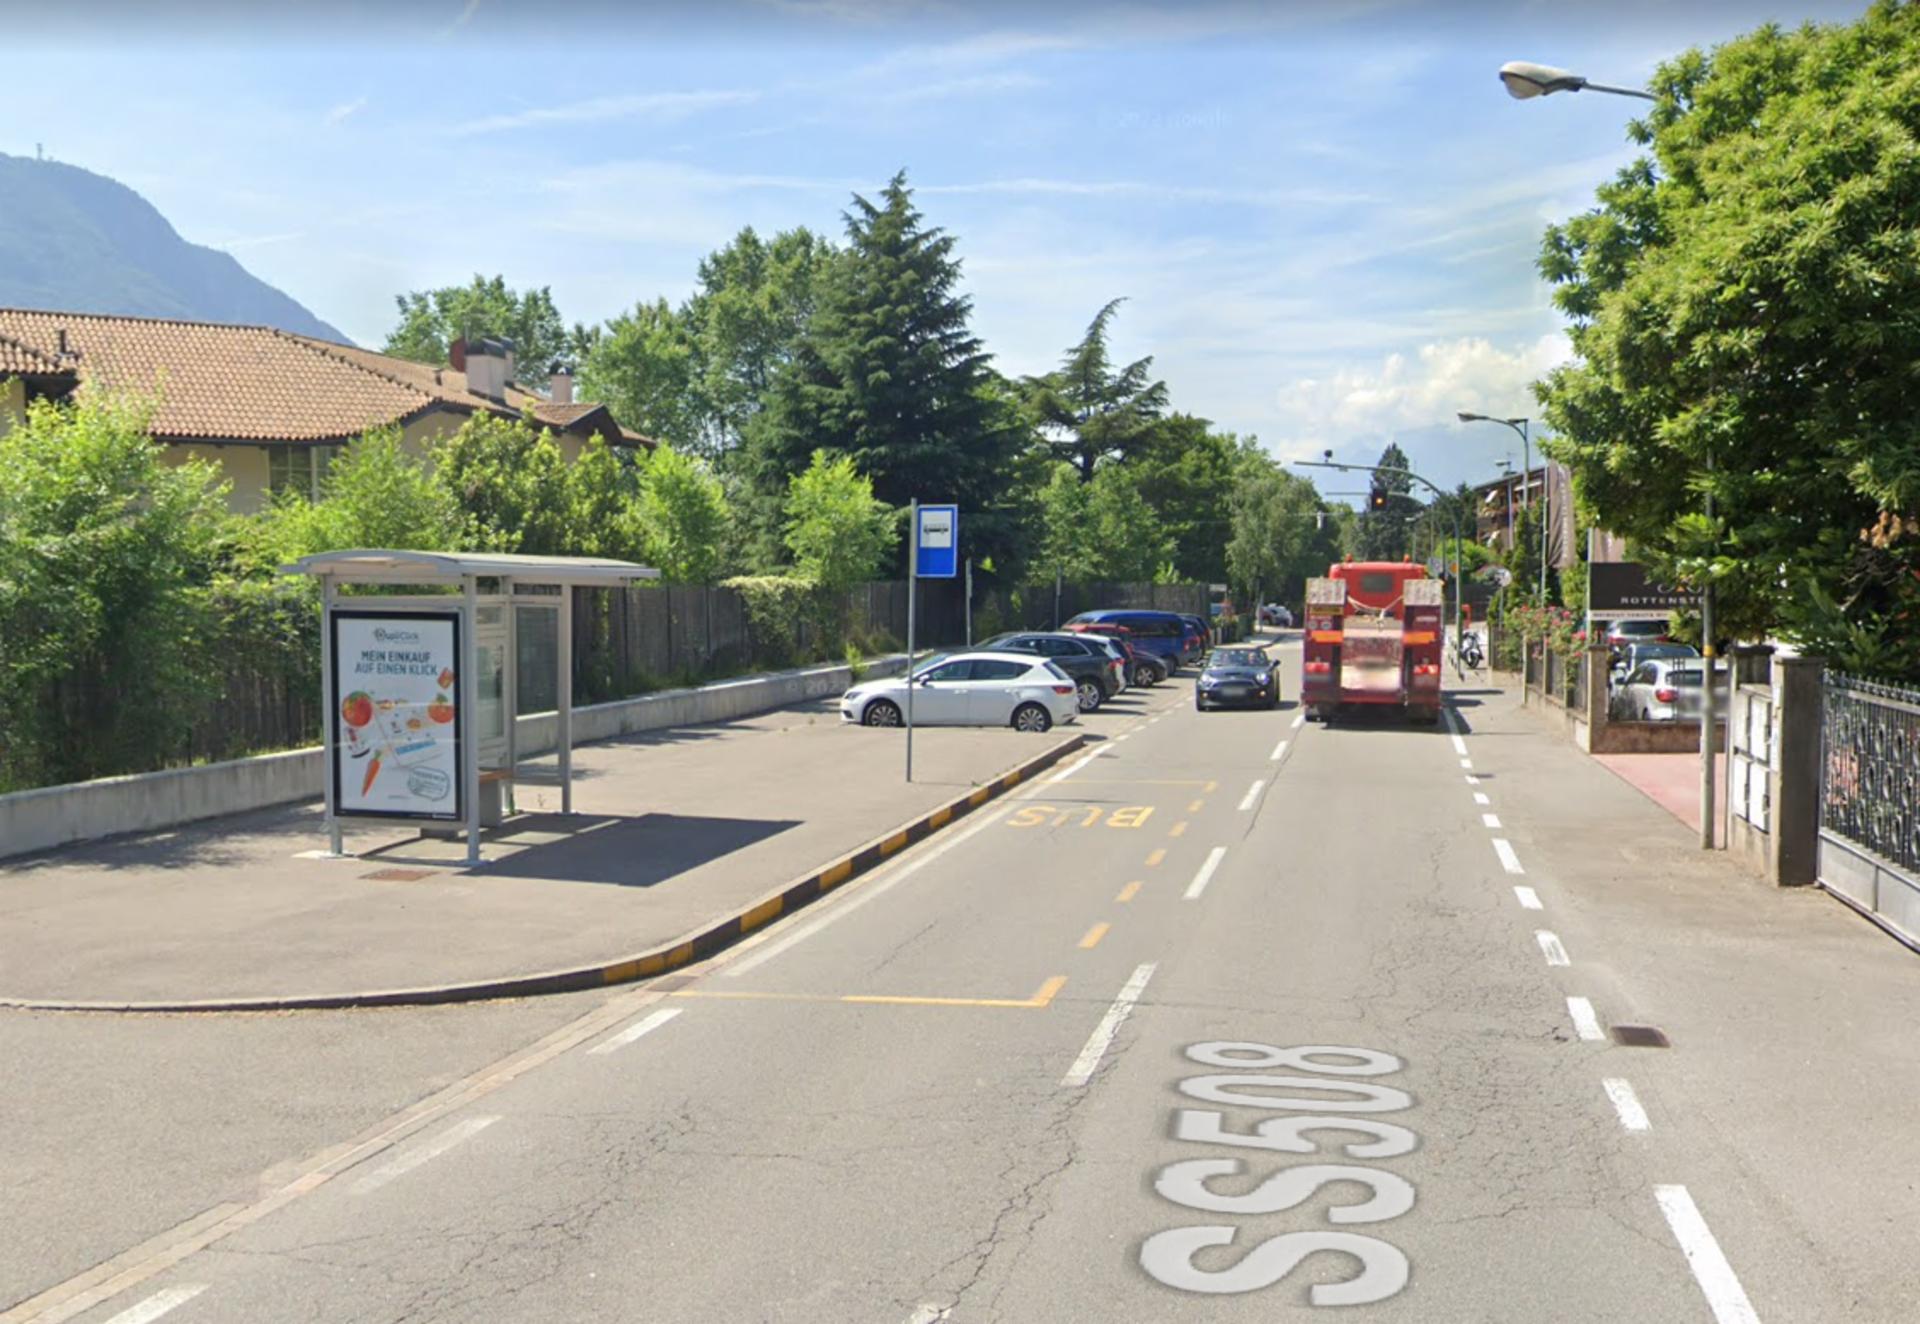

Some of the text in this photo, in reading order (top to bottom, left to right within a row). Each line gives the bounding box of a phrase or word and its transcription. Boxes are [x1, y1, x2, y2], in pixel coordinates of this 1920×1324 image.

[361, 650, 431, 663] MEIN EINKAUF
[355, 663, 438, 676] AUF EINEN KLICK
[1006, 805, 1156, 828] BUS
